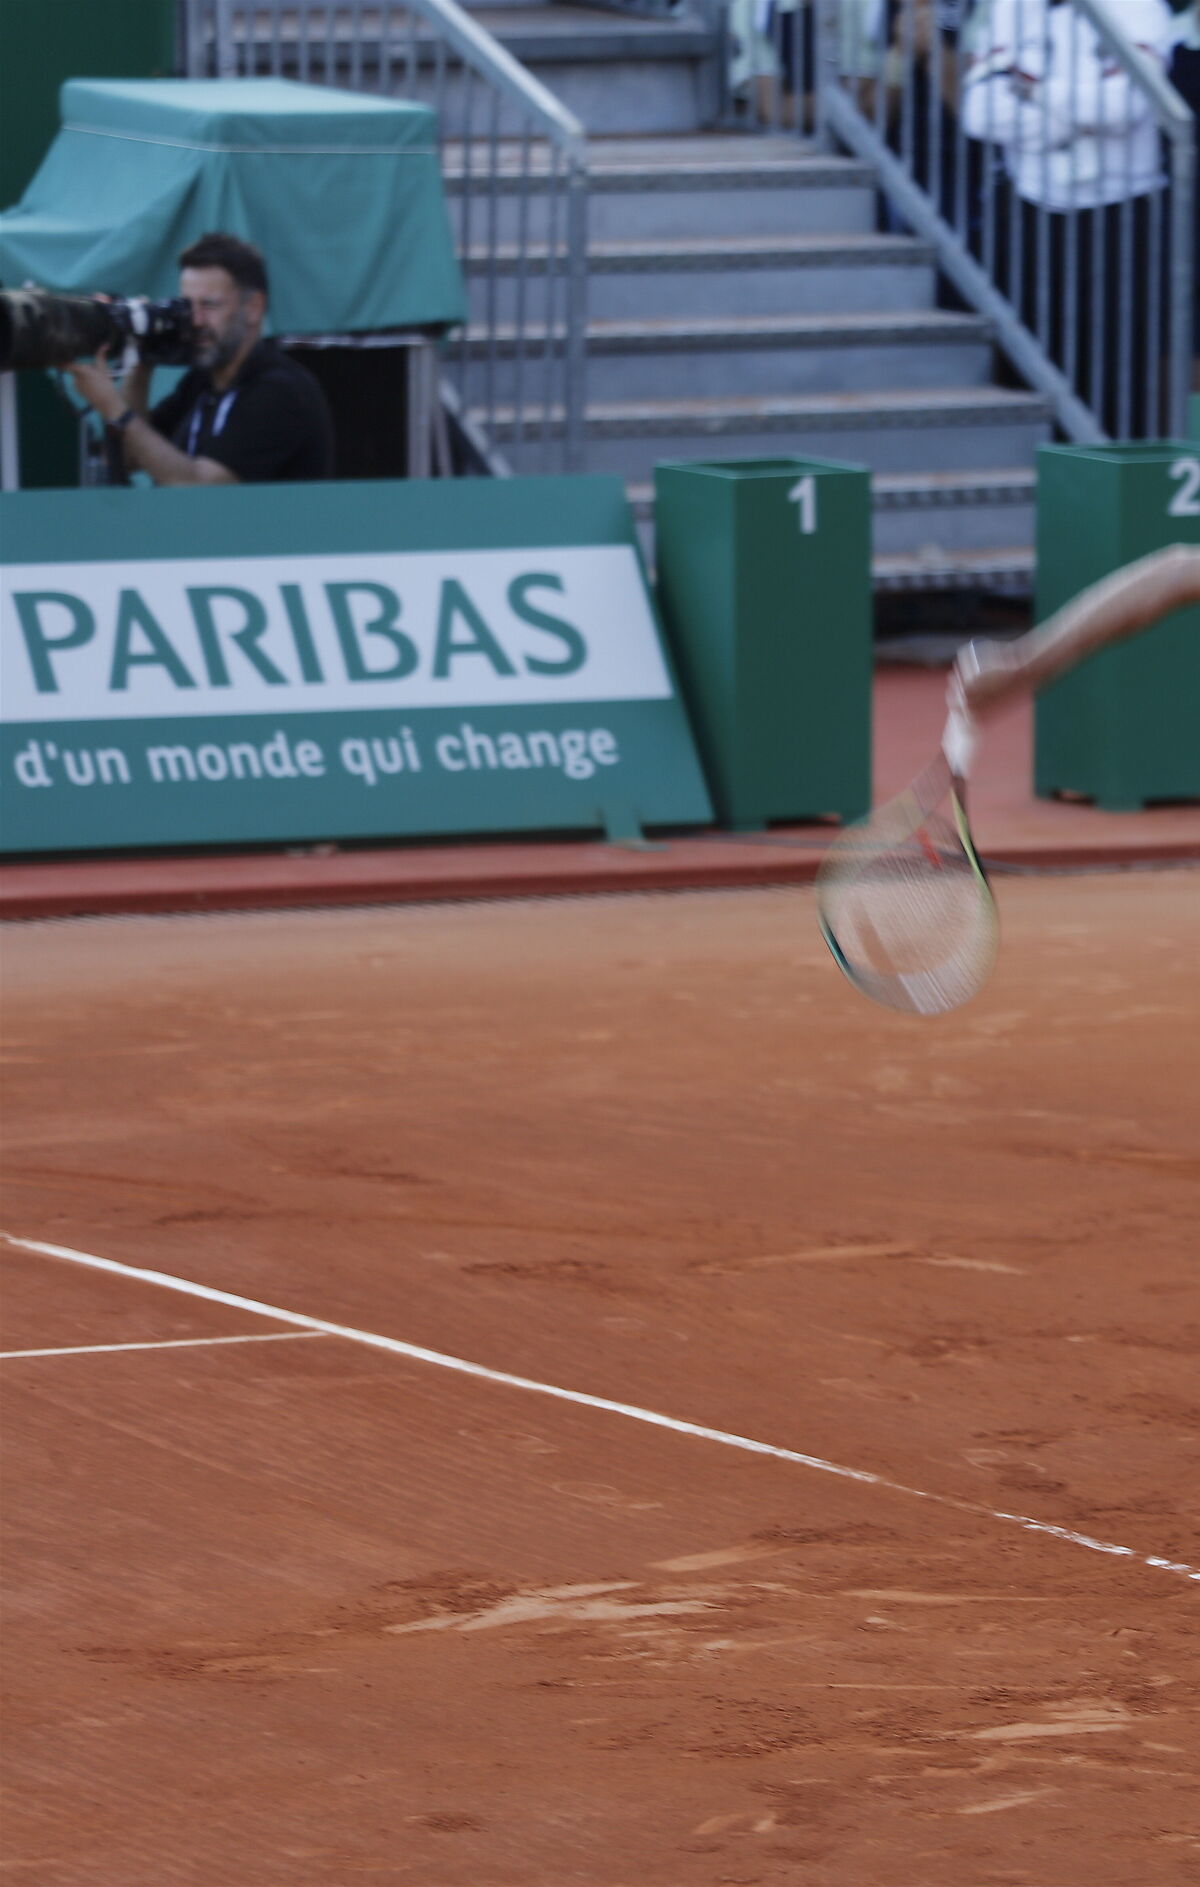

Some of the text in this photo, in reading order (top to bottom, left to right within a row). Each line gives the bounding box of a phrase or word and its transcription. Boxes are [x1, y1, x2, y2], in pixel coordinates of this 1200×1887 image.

[788, 474, 817, 535] 1
[11, 571, 588, 694] PARIBAS
[14, 724, 620, 788] d'un monde qui change
